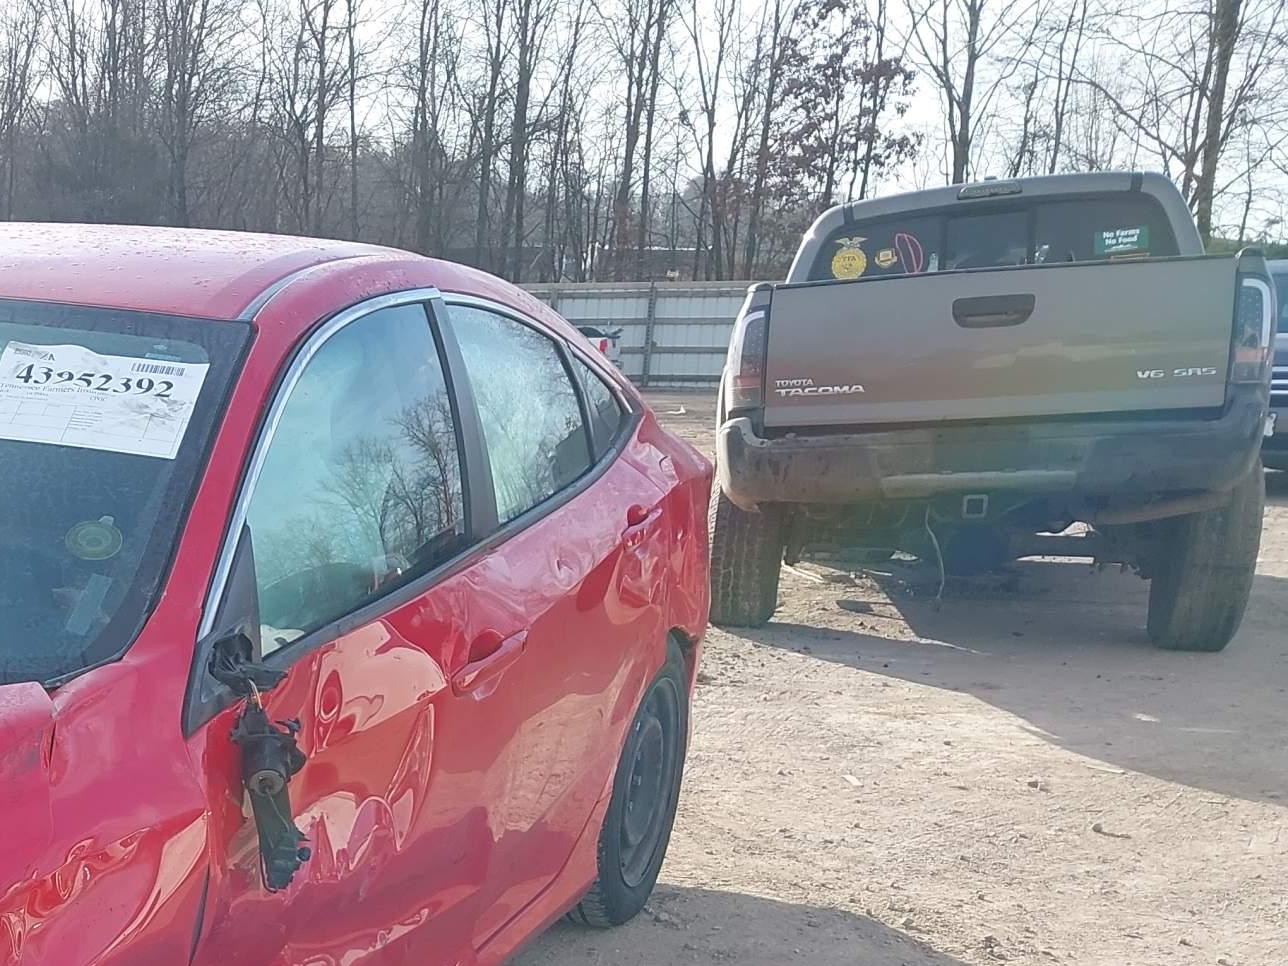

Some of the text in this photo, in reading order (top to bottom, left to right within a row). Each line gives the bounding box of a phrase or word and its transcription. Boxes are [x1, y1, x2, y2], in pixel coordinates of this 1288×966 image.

[1137, 367, 1217, 378] V6 SR5
[15, 363, 175, 399] 43952392
[775, 378, 815, 388] TOYOTA
[775, 384, 865, 397] TACOMA
